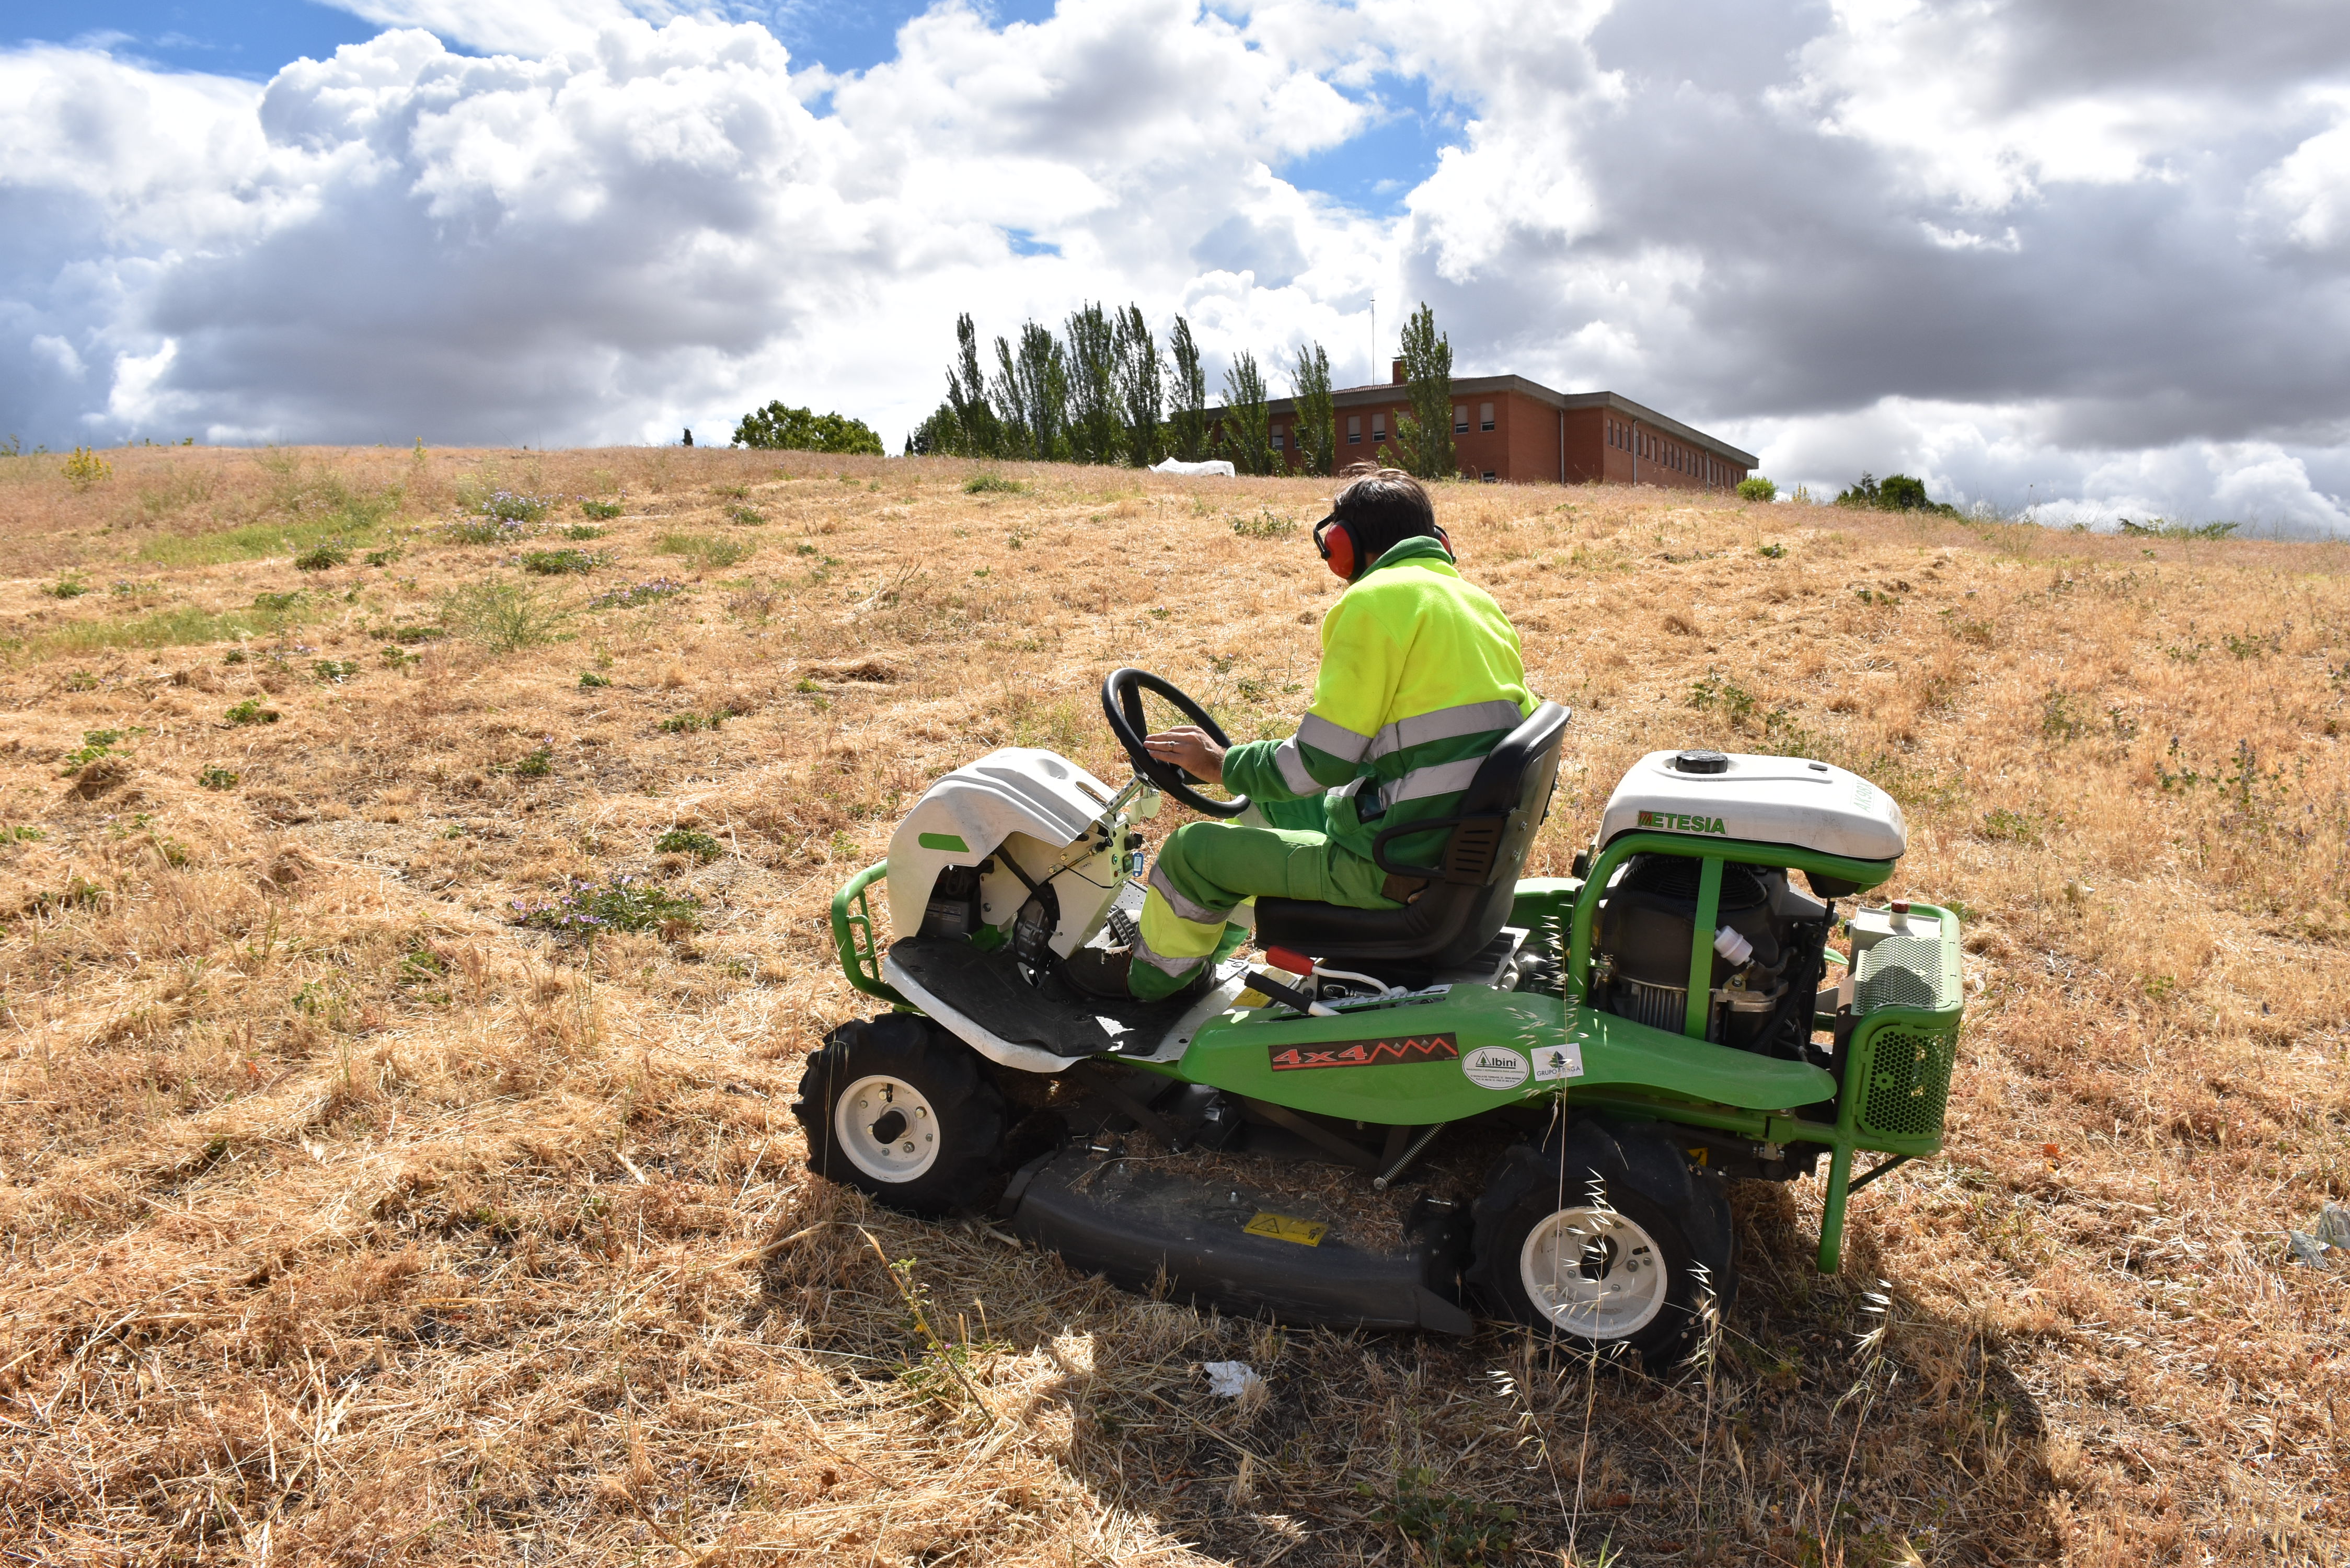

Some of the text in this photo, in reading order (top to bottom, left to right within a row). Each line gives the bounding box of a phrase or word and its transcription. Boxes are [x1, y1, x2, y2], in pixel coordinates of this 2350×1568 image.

[1853, 779, 1873, 813] AK98X
[1651, 811, 1726, 835] ETESIA
[1272, 1045, 1368, 1064] 4x4
[1476, 1051, 1516, 1067] Albini
